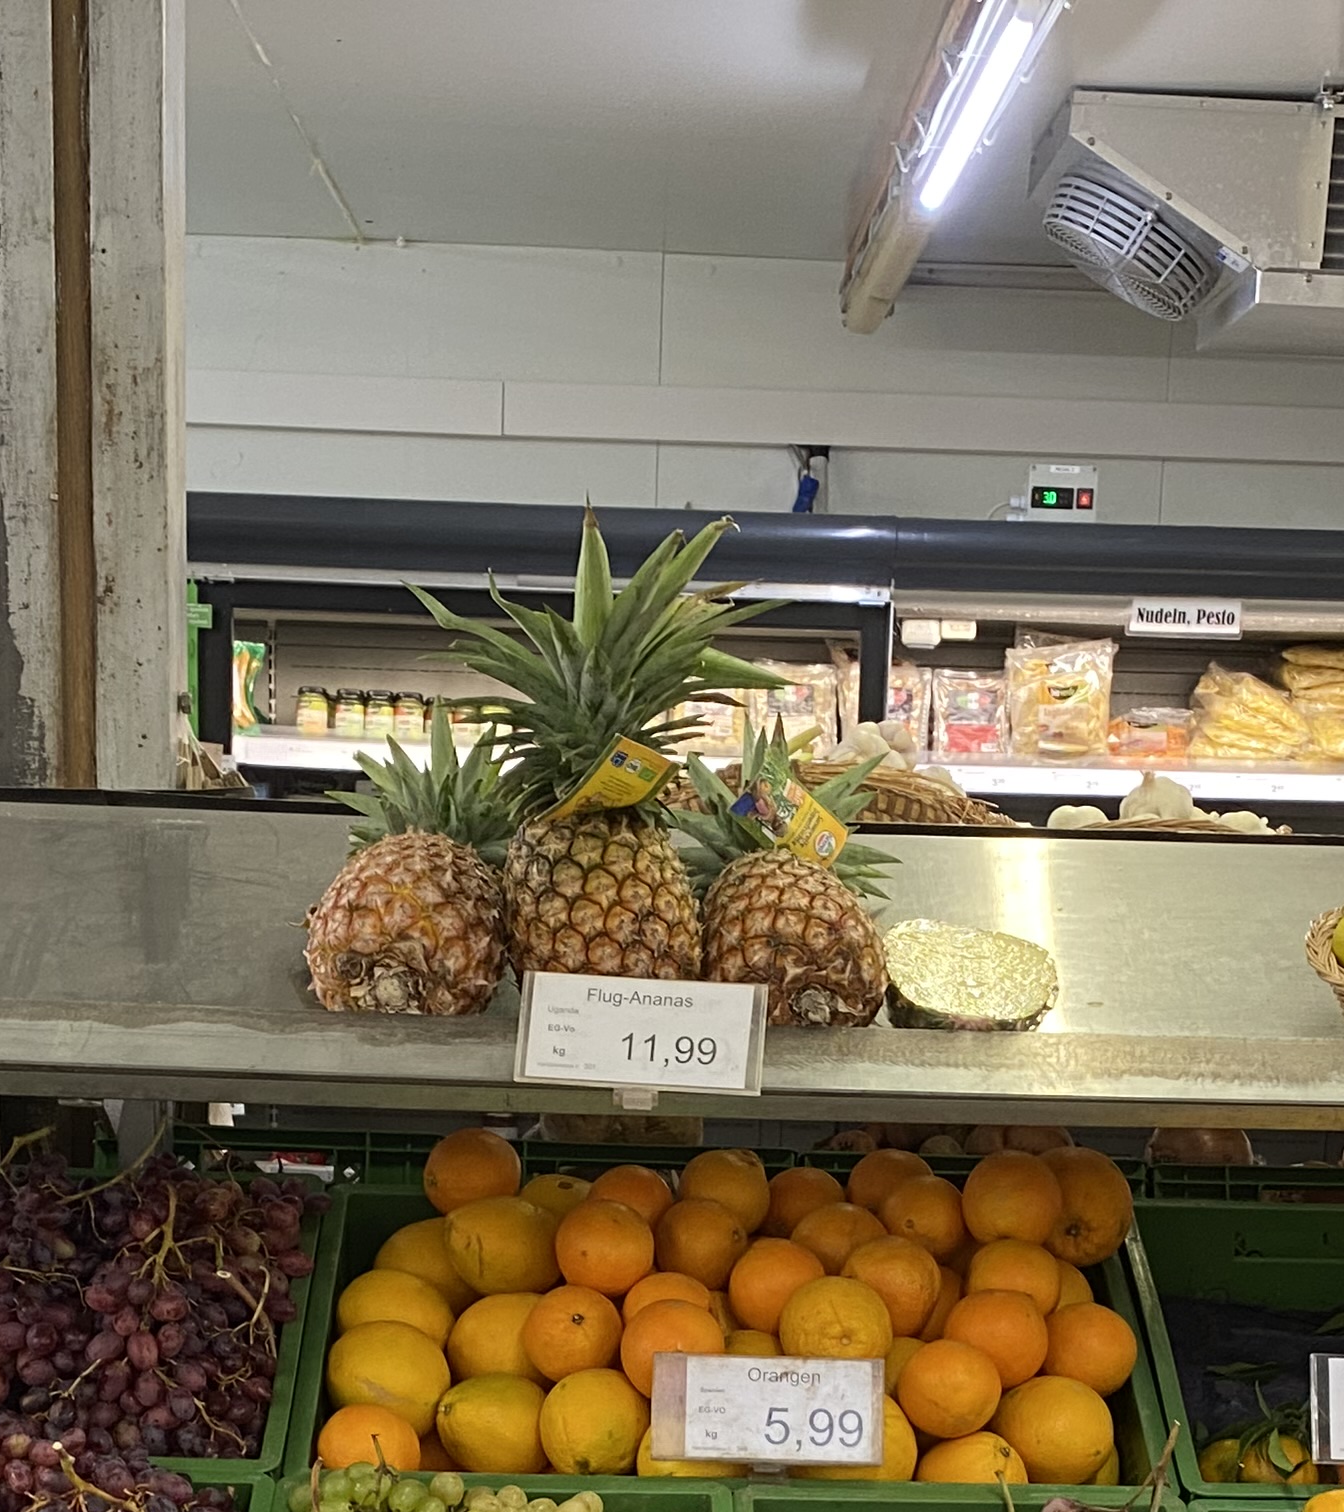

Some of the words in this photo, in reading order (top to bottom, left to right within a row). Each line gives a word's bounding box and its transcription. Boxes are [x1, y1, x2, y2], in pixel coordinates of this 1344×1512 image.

[1137, 607, 1190, 625] Nudeln,
[1196, 609, 1235, 625] Pesto
[586, 988, 694, 1008] Flug-Ananas
[552, 1046, 566, 1057] kg
[621, 1032, 717, 1068] 11,99
[747, 1367, 821, 1386] Orangen
[698, 1406, 726, 1414] EG-VO
[705, 1429, 718, 1440] kg
[764, 1406, 864, 1452] 5,99
